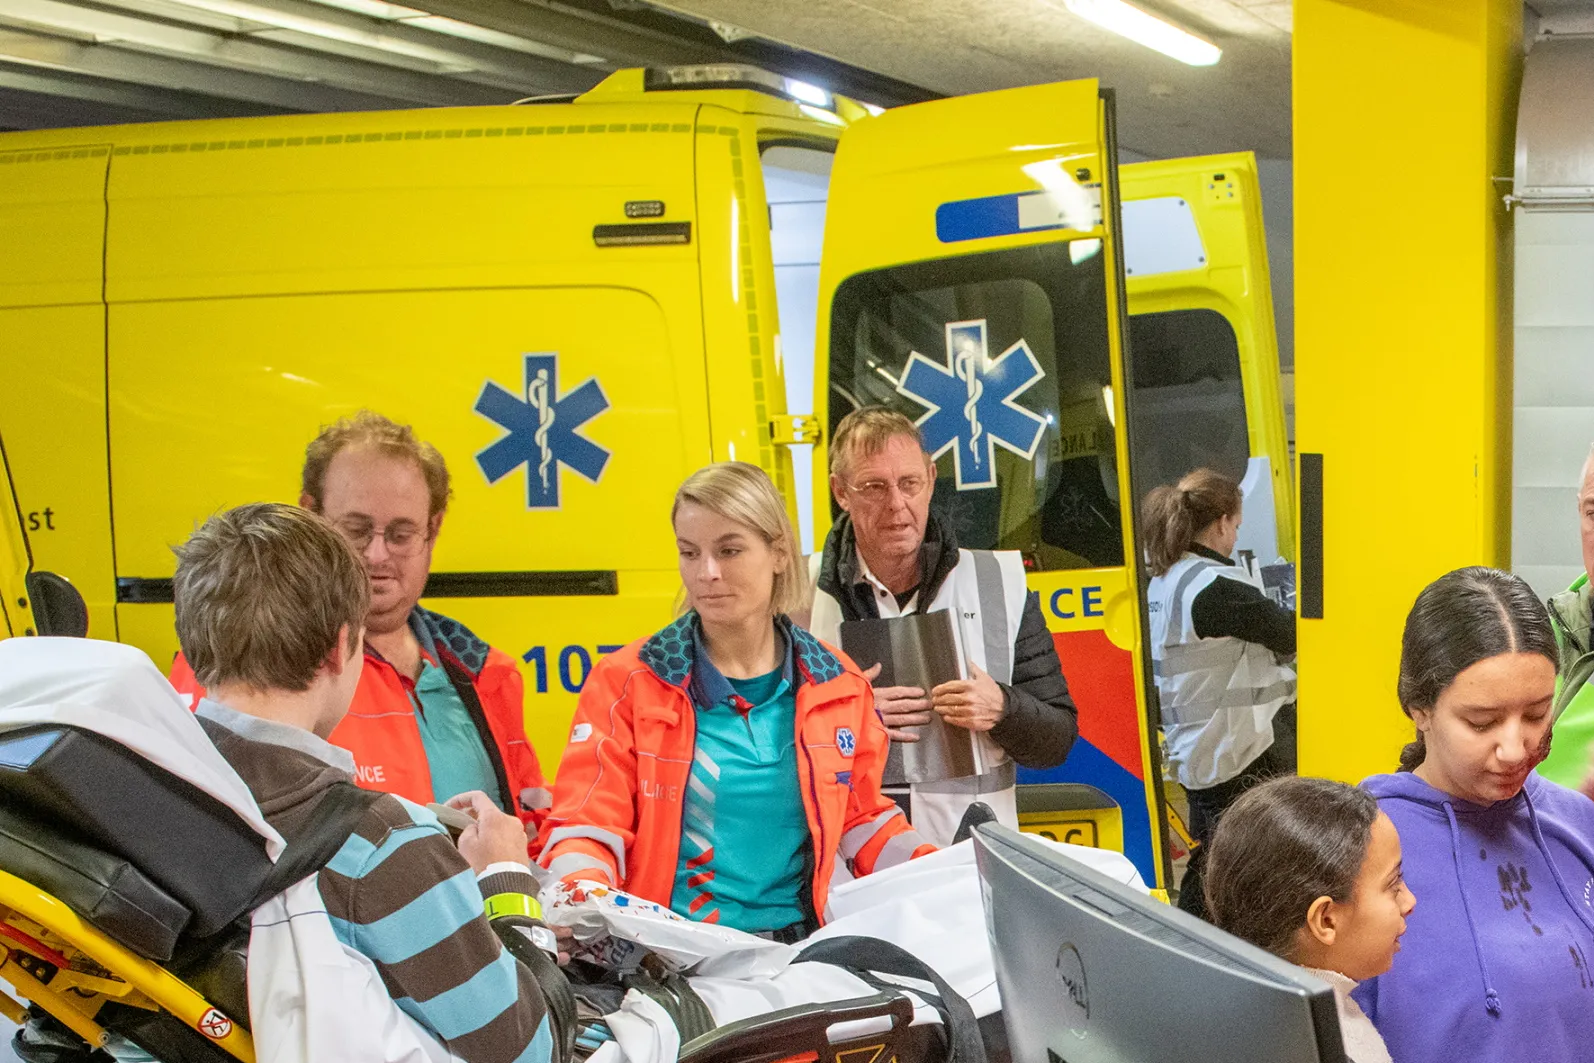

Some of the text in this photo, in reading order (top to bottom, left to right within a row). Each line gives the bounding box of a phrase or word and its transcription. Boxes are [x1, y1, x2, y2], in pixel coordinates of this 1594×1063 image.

[25, 507, 56, 531] st
[522, 644, 624, 693] 10
[353, 765, 386, 783] NCE
